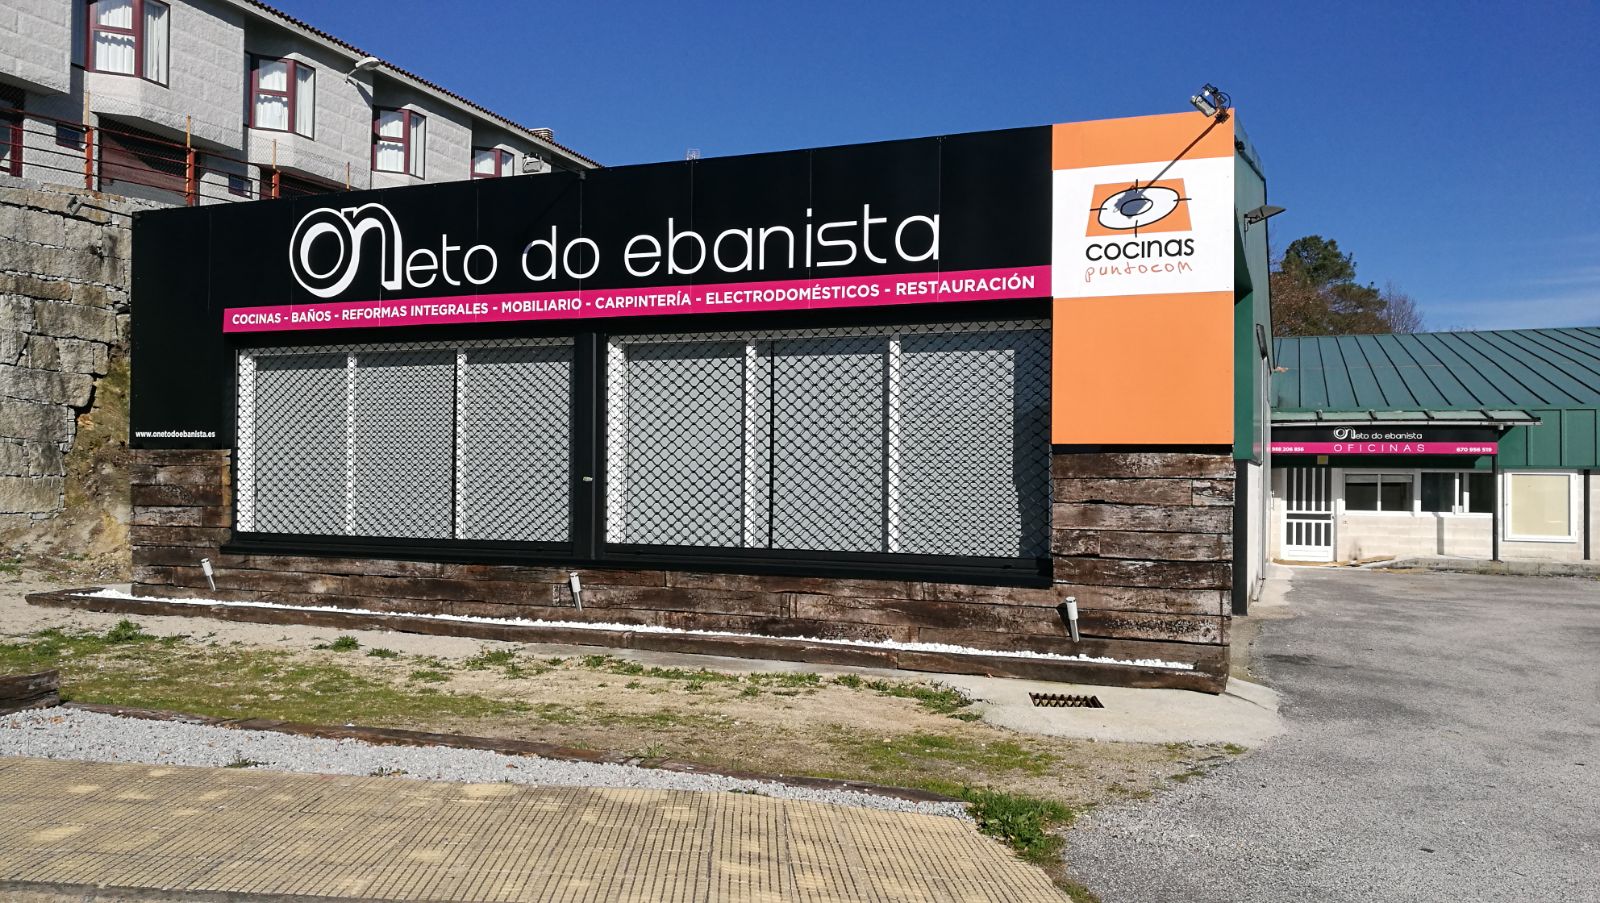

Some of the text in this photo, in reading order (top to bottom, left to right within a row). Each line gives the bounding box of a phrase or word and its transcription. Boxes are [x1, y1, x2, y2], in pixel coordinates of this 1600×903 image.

[521, 225, 600, 282] do
[623, 204, 940, 278] ebanista
[1085, 238, 1195, 261] cocinas
[1085, 261, 1193, 283] puntocom
[232, 312, 282, 325] COCINAS
[291, 308, 332, 323] BAÑOS
[342, 307, 407, 321] REFORMAS
[410, 302, 488, 317] INTEGRALES
[501, 297, 583, 314] MOBILIARIO
[595, 290, 692, 310] CARPINTERÍA
[706, 283, 880, 305] ELECTRODOMÉSTICOS
[895, 272, 1036, 296] RESTAURACIÓN
[1371, 432, 1383, 440] do
[1384, 432, 1423, 440] ebanista
[1333, 444, 1425, 453] OFICINAS
